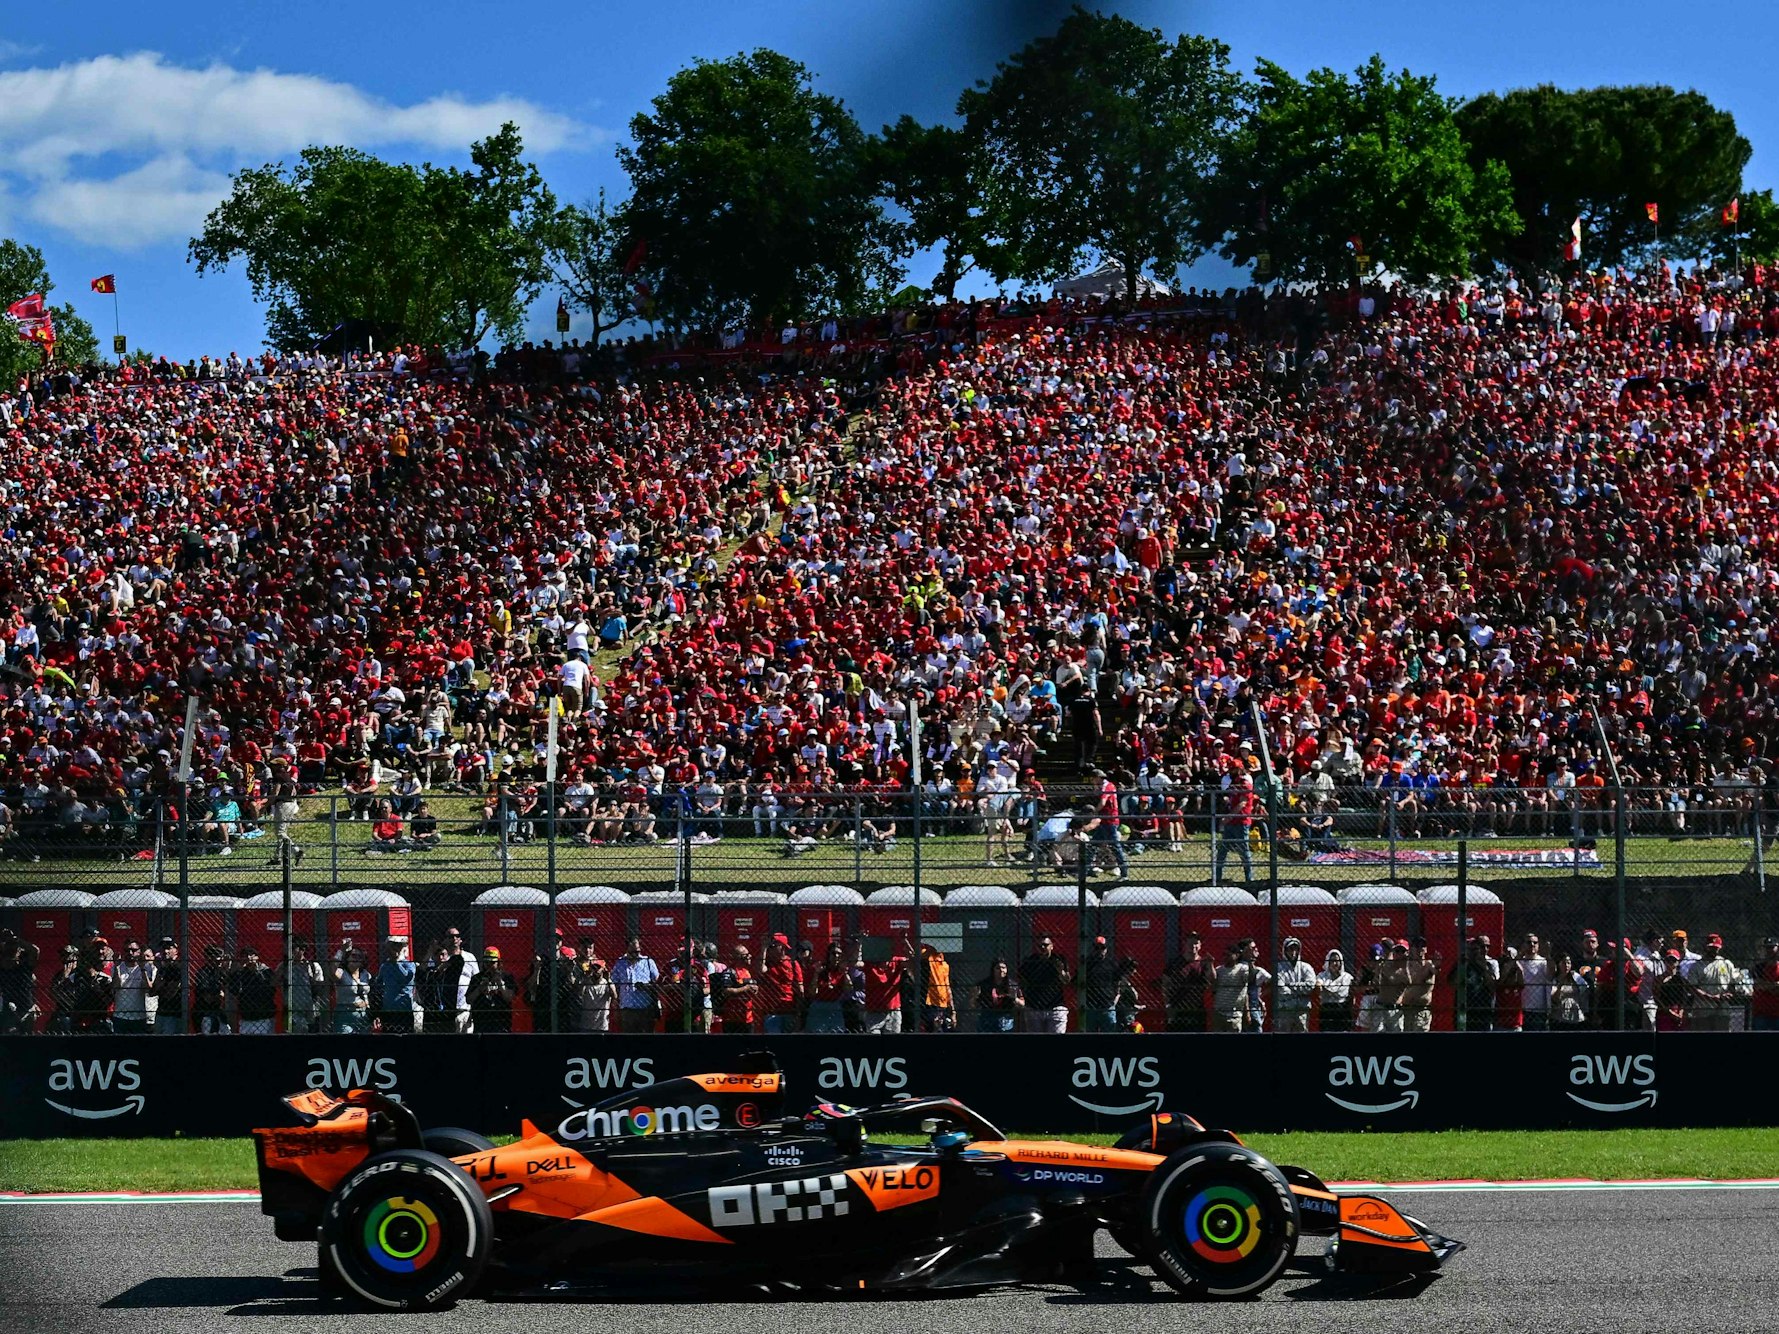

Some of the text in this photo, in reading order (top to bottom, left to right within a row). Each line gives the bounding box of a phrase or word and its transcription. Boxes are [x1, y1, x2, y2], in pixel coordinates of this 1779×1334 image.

[49, 1058, 141, 1091] aws
[306, 1057, 397, 1089] aws
[564, 1057, 655, 1089] aws
[705, 1075, 774, 1089] avenga
[818, 1056, 908, 1089] aws
[1071, 1056, 1161, 1088] aws
[1328, 1055, 1416, 1086] aws
[1569, 1054, 1656, 1086] aws
[558, 1103, 720, 1141] chrome
[527, 1156, 576, 1175] DELL
[1018, 1148, 1109, 1162] RICHARD MILLE
[860, 1168, 934, 1191] VELO
[1034, 1169, 1105, 1184] DP WORLD
[708, 1174, 849, 1227] OKX
[1347, 1210, 1390, 1222] workday
